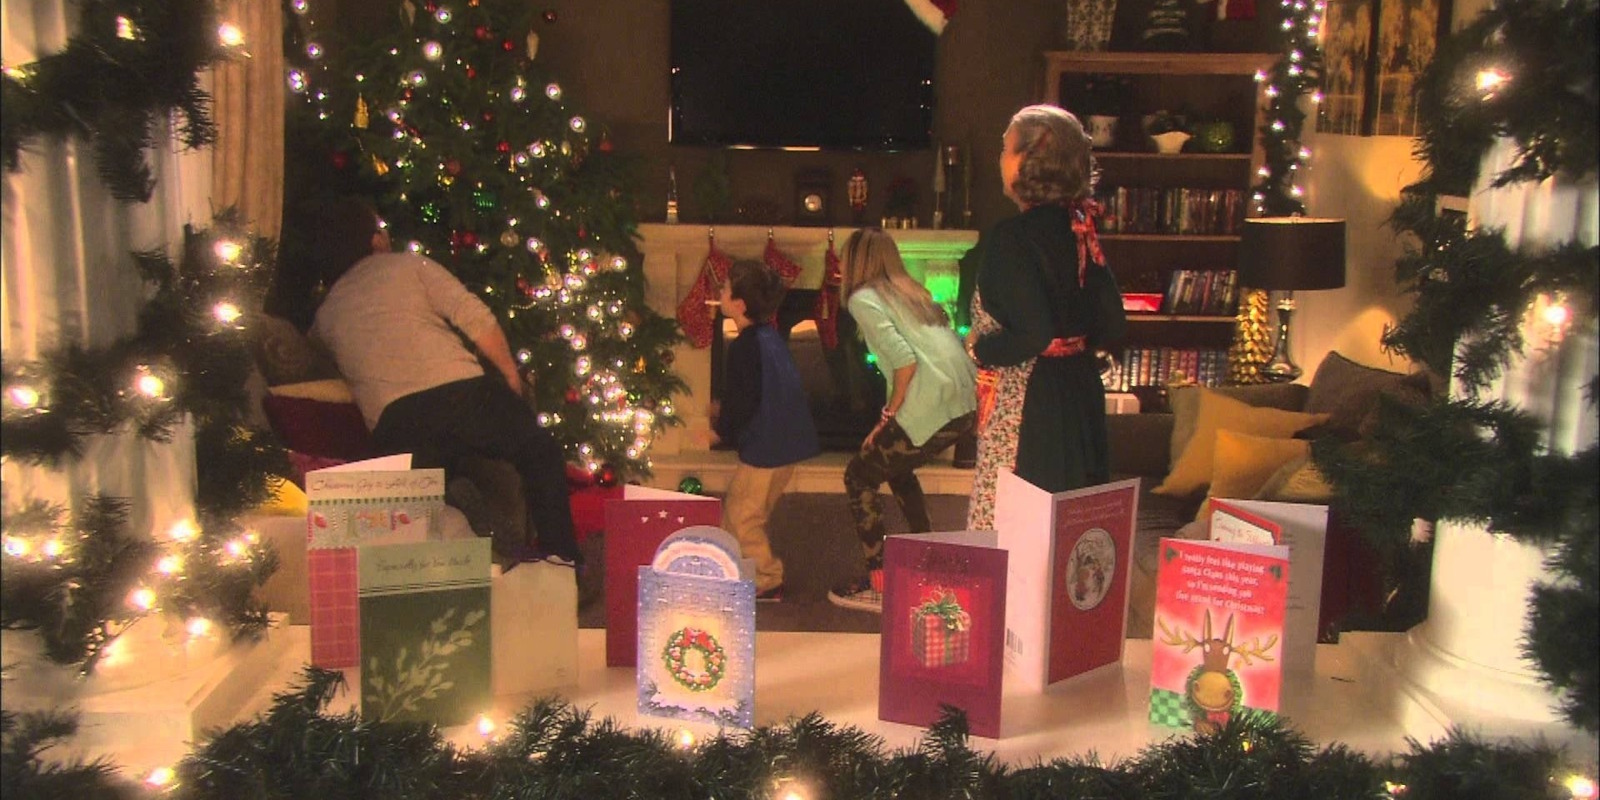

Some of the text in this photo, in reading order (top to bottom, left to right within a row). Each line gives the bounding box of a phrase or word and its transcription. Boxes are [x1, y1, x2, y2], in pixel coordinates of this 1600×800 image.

[1184, 553, 1205, 566] really
[1206, 555, 1221, 566] feel
[1221, 557, 1236, 569] like
[1237, 561, 1264, 575] playing
[1203, 567, 1224, 580] Claus
[1225, 572, 1239, 583] this
[1186, 581, 1196, 589] so
[1209, 583, 1237, 597] sending
[1239, 588, 1252, 599] you
[1212, 596, 1224, 606] for
